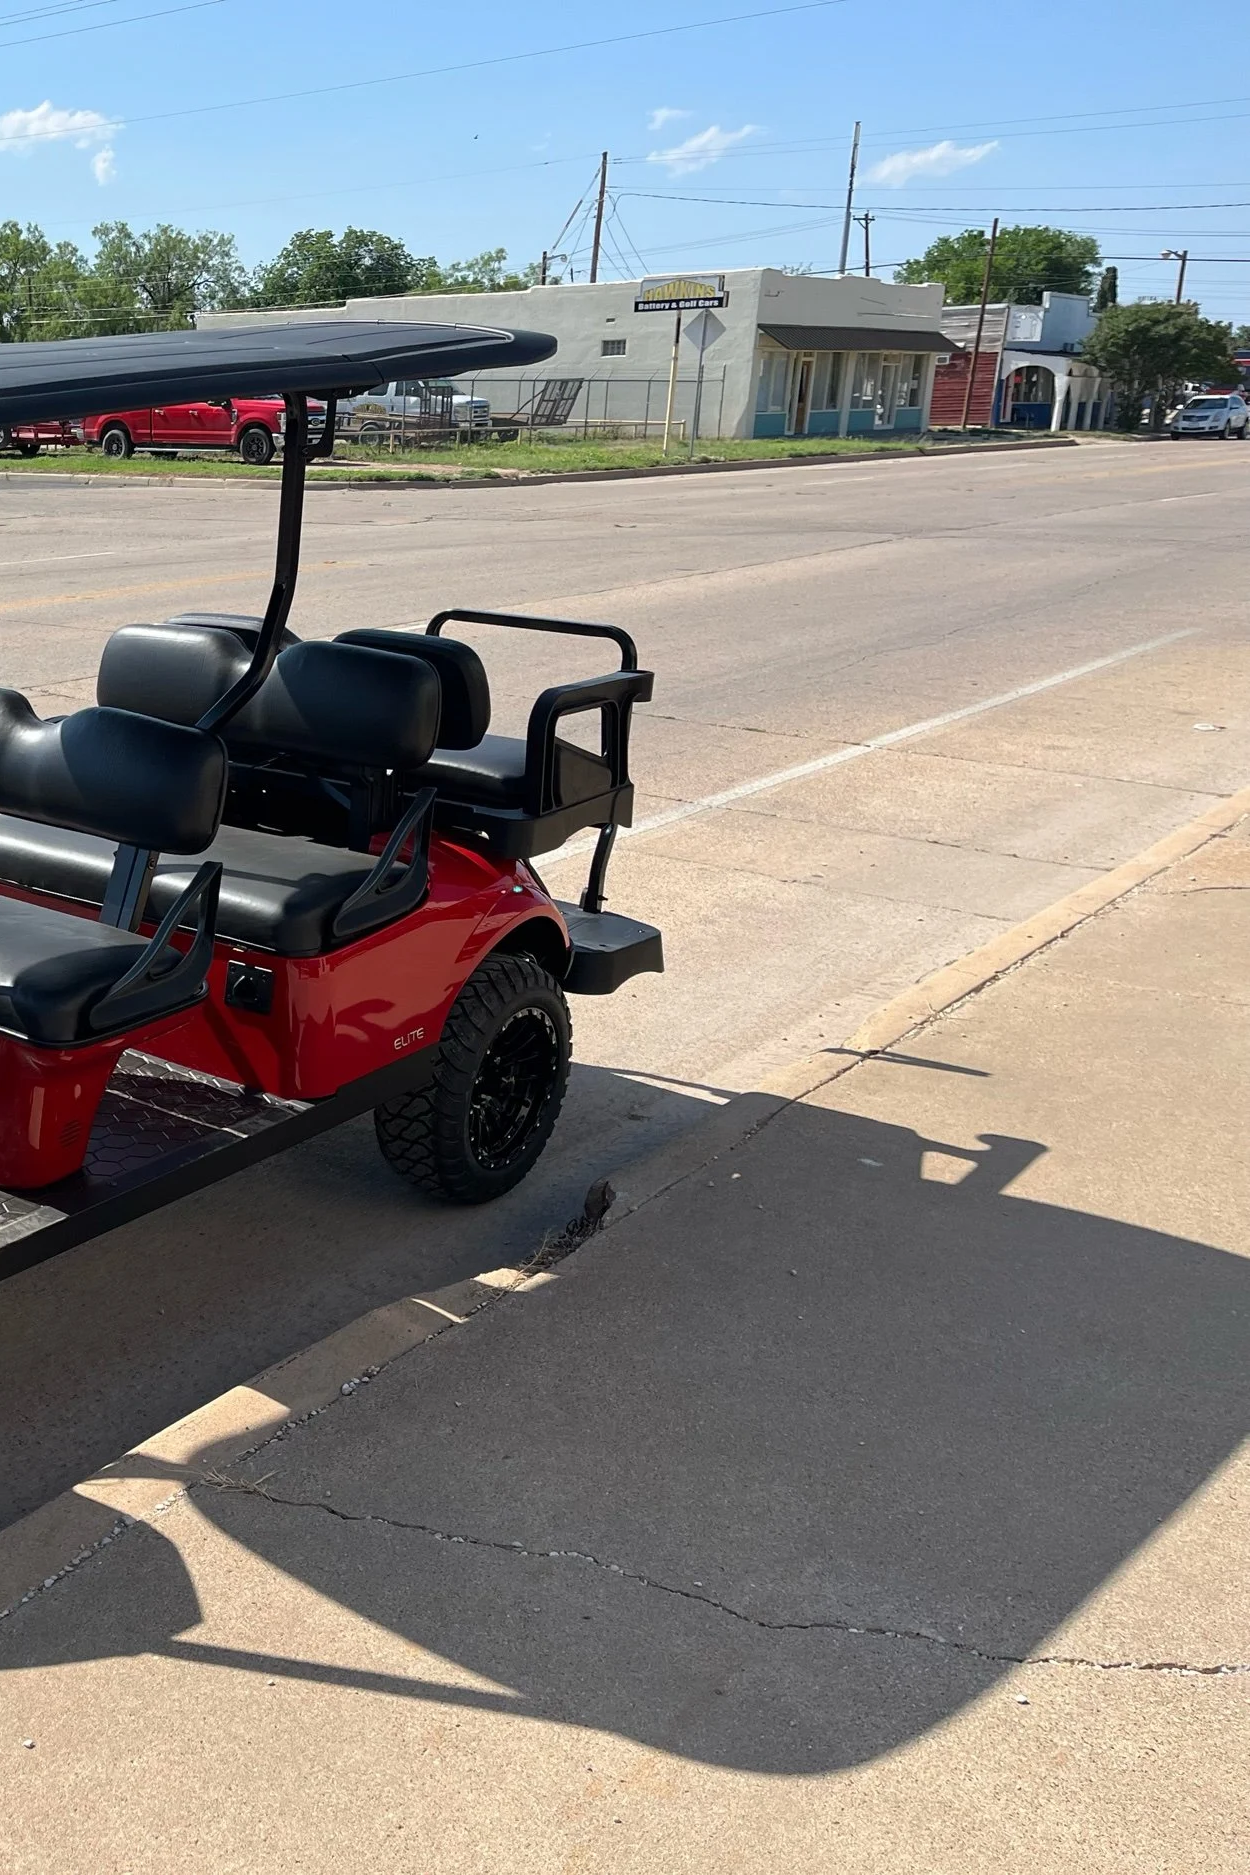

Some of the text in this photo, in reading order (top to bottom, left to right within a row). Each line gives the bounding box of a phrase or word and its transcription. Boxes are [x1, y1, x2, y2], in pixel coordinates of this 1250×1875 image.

[643, 279, 717, 302] HAWKINS
[638, 299, 719, 311] Battery & Golf Cars
[393, 1027, 425, 1050] ELITE
